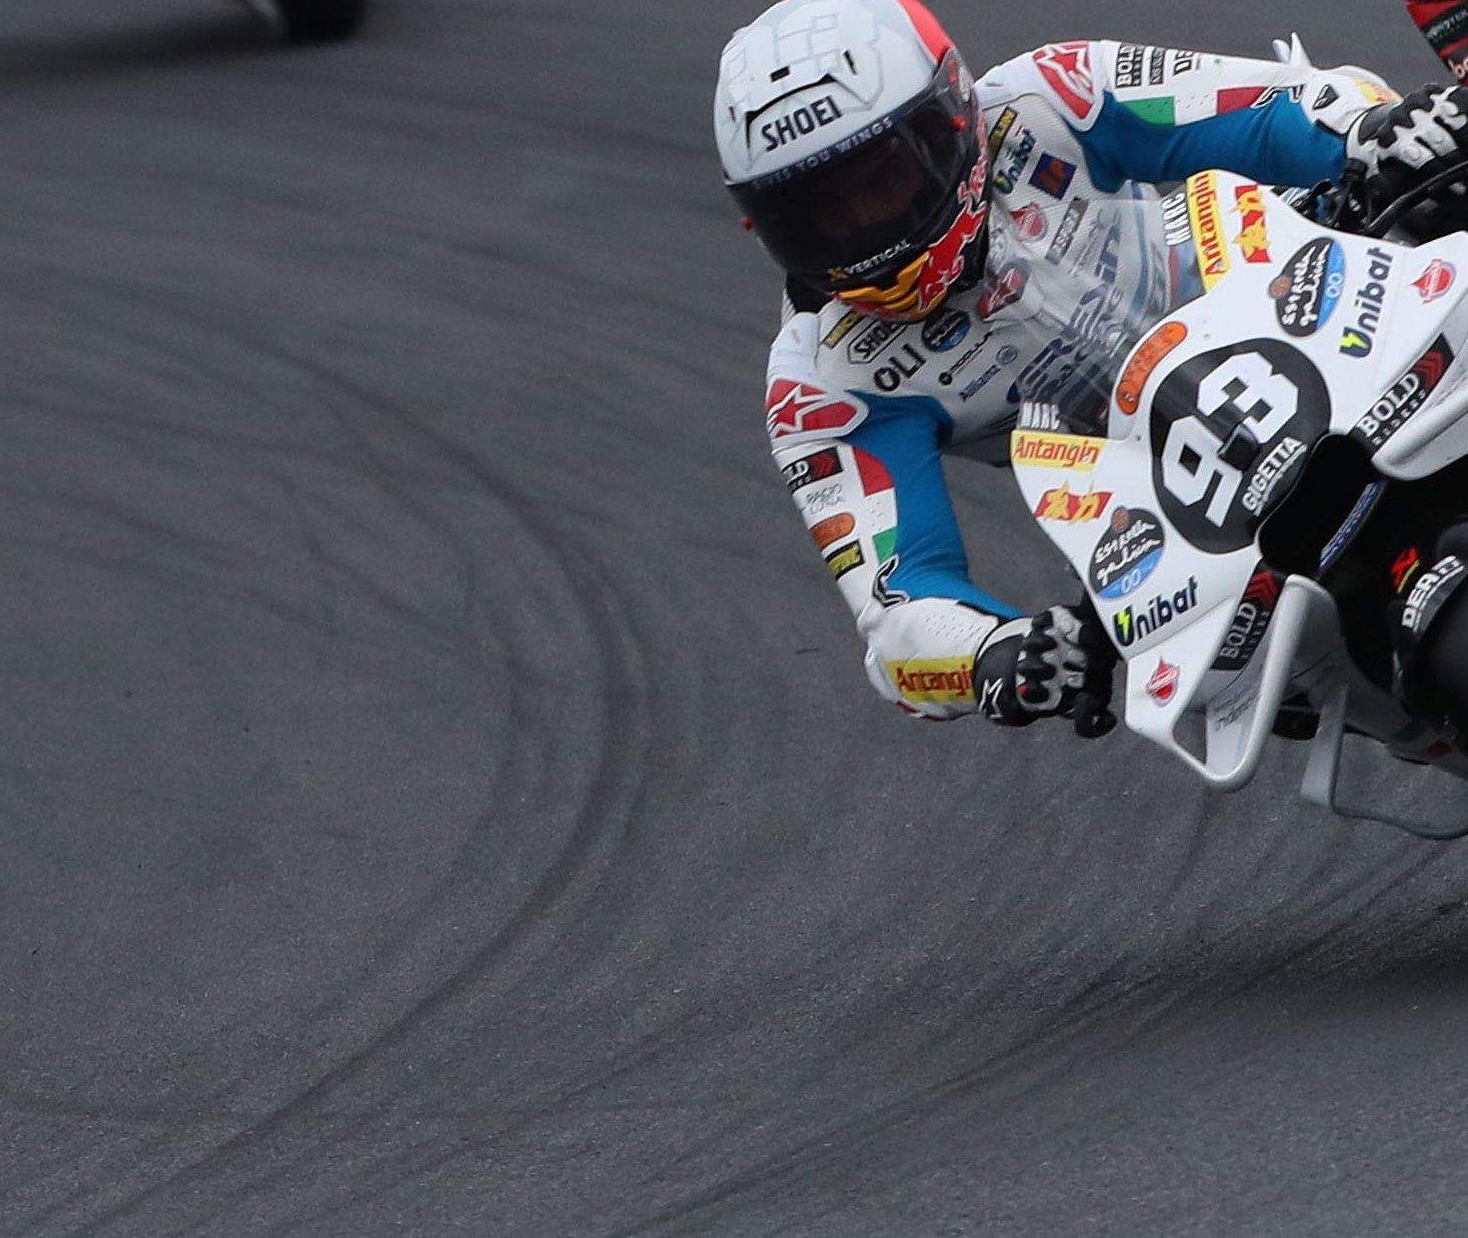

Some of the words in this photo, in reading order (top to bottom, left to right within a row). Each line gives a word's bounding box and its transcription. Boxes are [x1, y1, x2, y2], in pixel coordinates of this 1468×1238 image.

[761, 95, 843, 153] SHOEI
[836, 117, 894, 155] WINGS
[1161, 192, 1193, 248] MARC
[1193, 172, 1227, 277] Antangin
[1339, 246, 1395, 359] Unibat
[1020, 401, 1062, 431] MARC
[1355, 371, 1422, 439] BOLD
[1014, 434, 1101, 468] Antangin
[1160, 350, 1301, 529] 93
[1241, 435, 1308, 513] GIGETTA
[1113, 576, 1199, 647] Unibat
[1220, 602, 1259, 660] BOLD
[895, 665, 974, 694] Antangi
